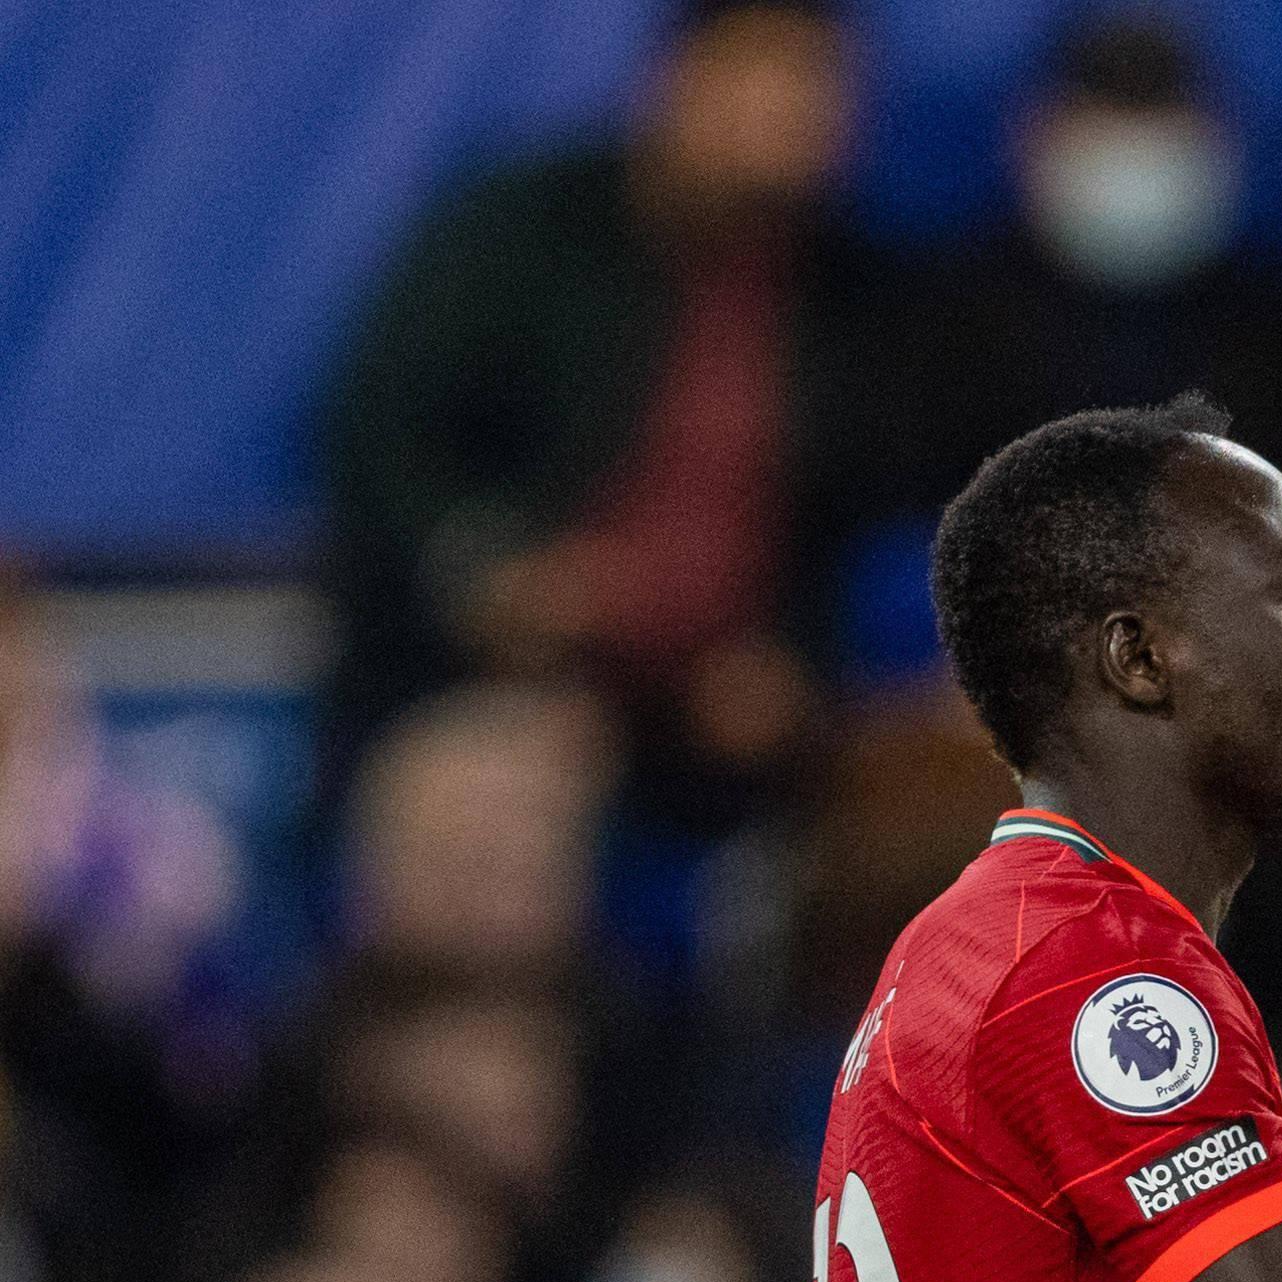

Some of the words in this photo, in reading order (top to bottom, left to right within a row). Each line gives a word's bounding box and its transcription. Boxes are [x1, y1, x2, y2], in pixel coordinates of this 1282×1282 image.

[1155, 1069, 1192, 1098] Premier
[1186, 1026, 1204, 1070] League
[1125, 1163, 1172, 1199] No
[1171, 1124, 1247, 1175] room
[1138, 1183, 1181, 1219] for
[1182, 1140, 1268, 1197] racism
